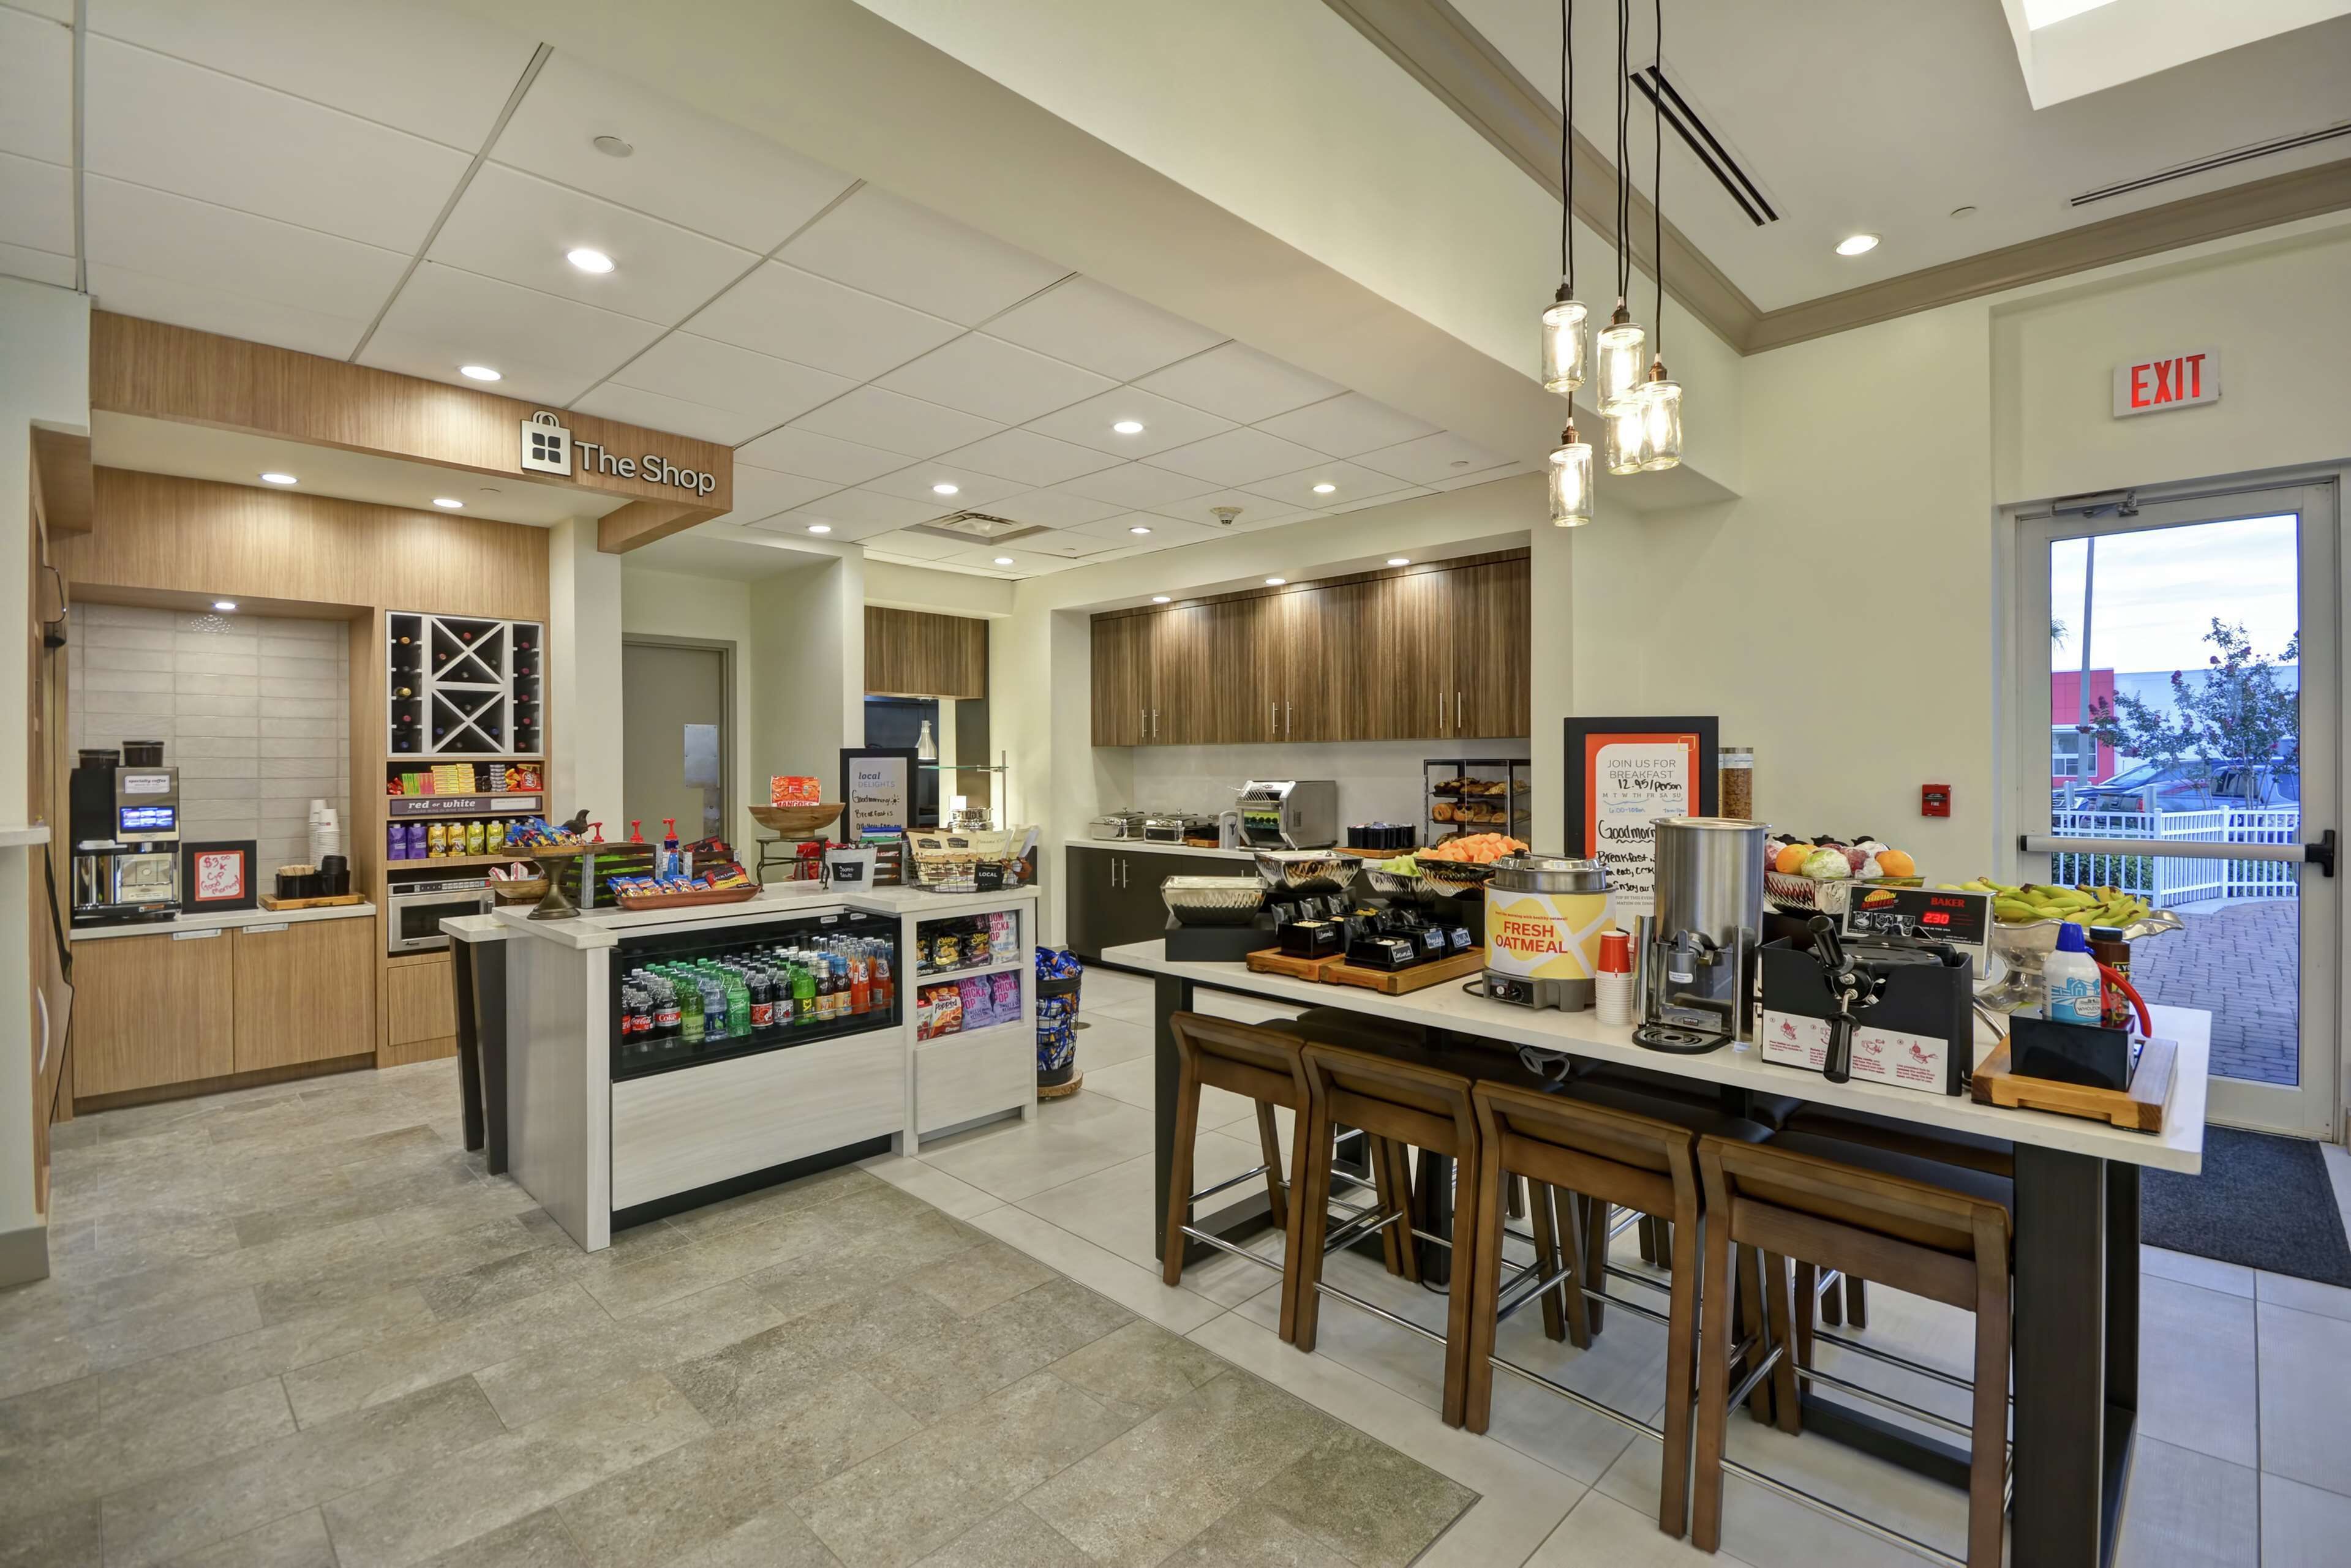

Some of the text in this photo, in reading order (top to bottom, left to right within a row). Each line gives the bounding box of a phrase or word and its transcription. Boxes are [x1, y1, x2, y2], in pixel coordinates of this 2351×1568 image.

[2131, 353, 2205, 408] EXIT
[574, 440, 716, 497] The Shop
[1608, 759, 1676, 768] JOIN US FOR
[1609, 770, 1674, 779] BREAKFAST
[408, 800, 429, 809] red
[443, 800, 476, 808] white
[1596, 850, 1648, 863] Breakfast
[1930, 897, 1965, 908] BAKER
[990, 921, 1010, 932] HICKA
[1503, 920, 1554, 938] FRESH
[990, 932, 1000, 942] OP
[1495, 934, 1568, 954] OATMEAL
[935, 999, 957, 1013] Popped
